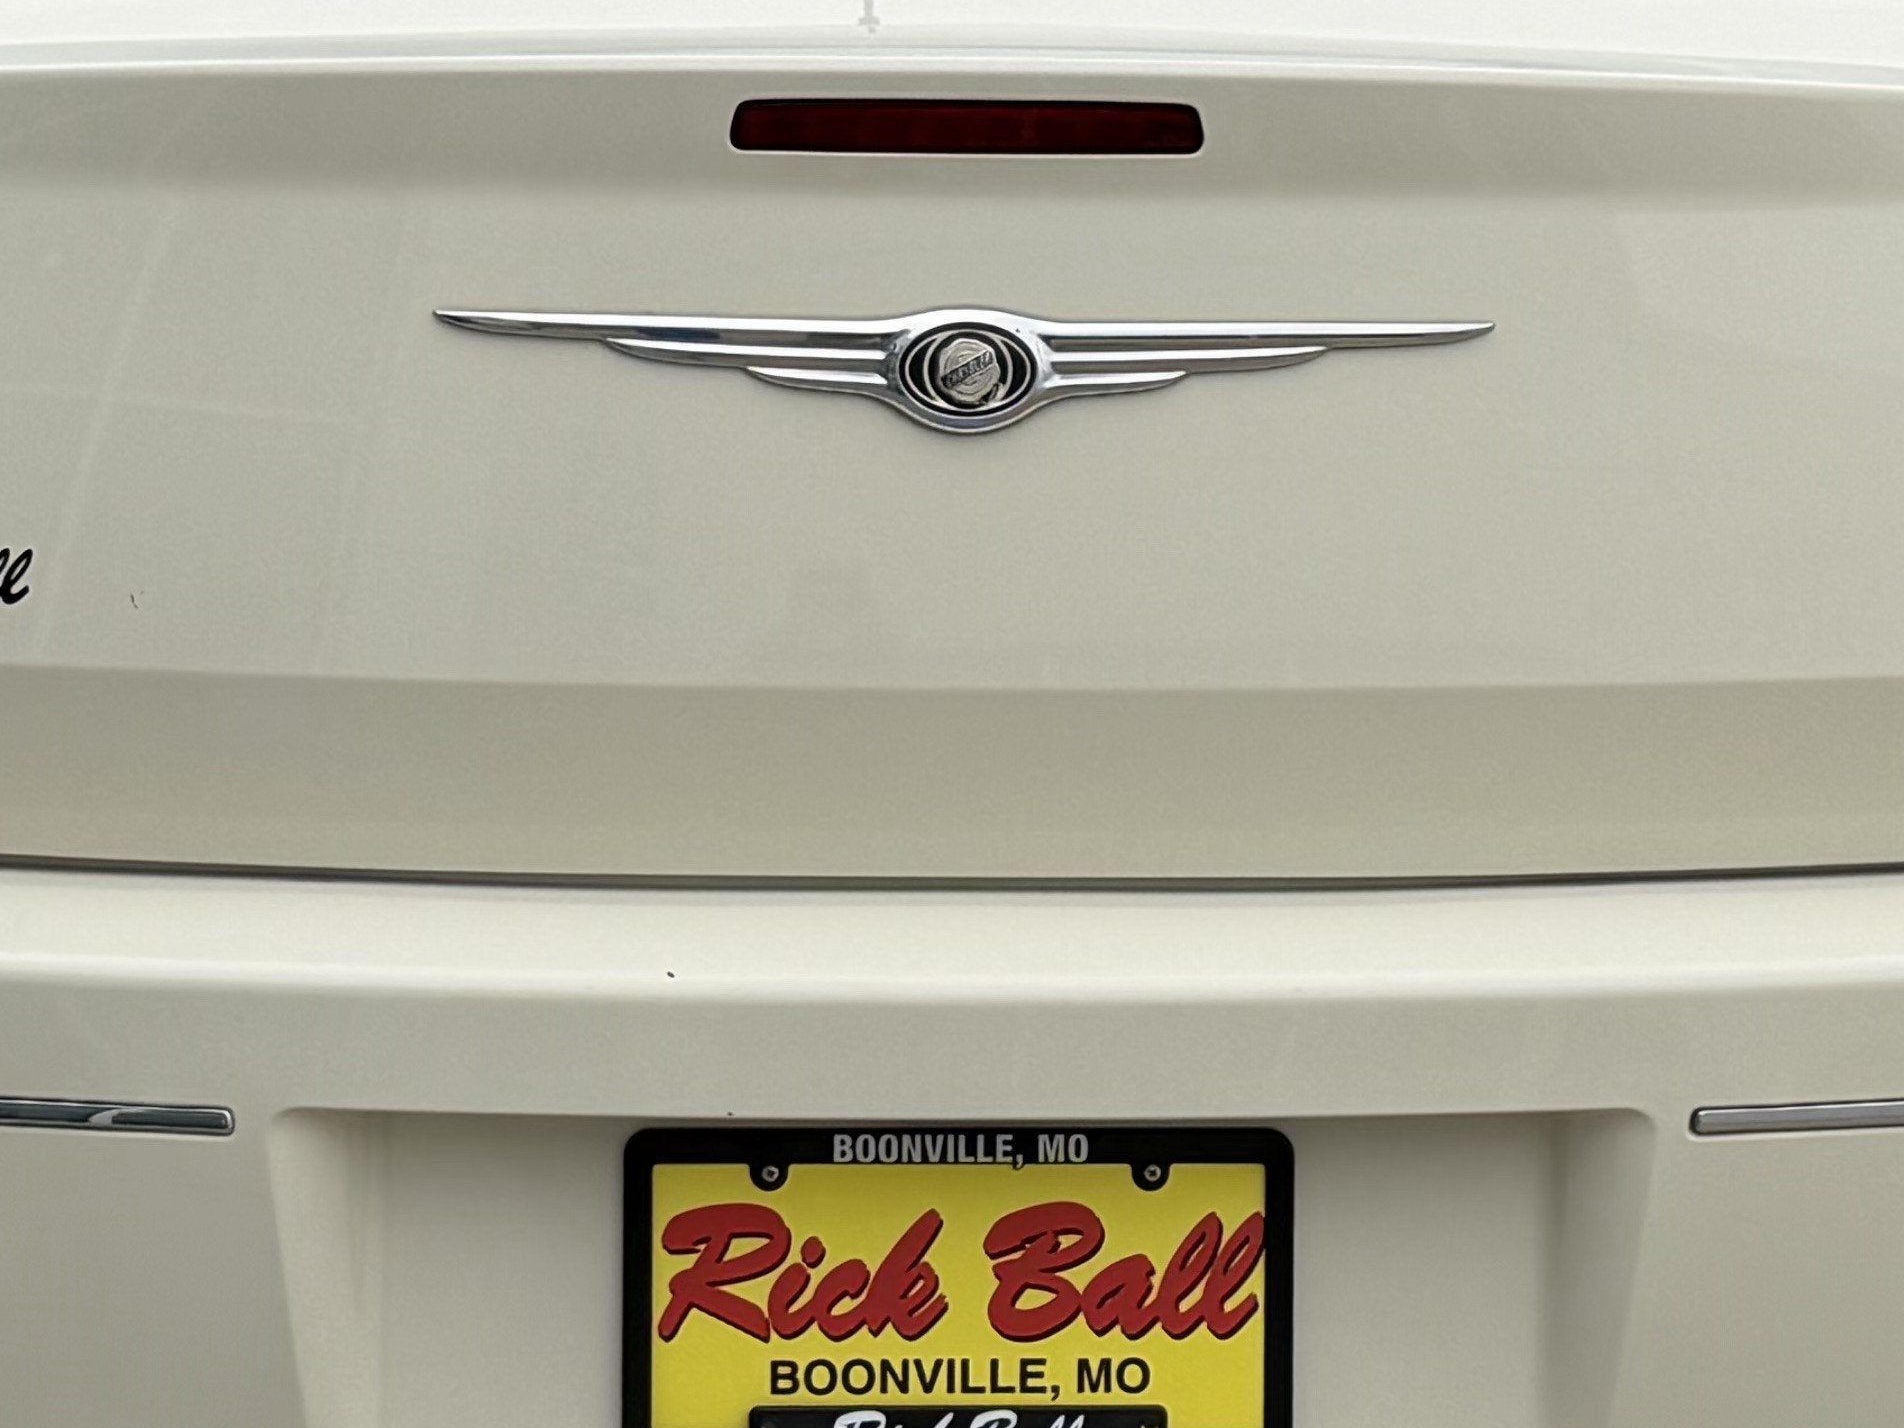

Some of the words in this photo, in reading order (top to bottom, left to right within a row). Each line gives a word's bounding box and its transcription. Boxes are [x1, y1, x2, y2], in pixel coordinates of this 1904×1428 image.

[833, 1133, 1025, 1169] BOONVILLE,
[1037, 1133, 1089, 1164] MO
[658, 1202, 949, 1343] Rick
[983, 1201, 1265, 1343] Ball
[770, 1358, 1061, 1400] BOONVILLE,
[1077, 1357, 1151, 1394] MO
